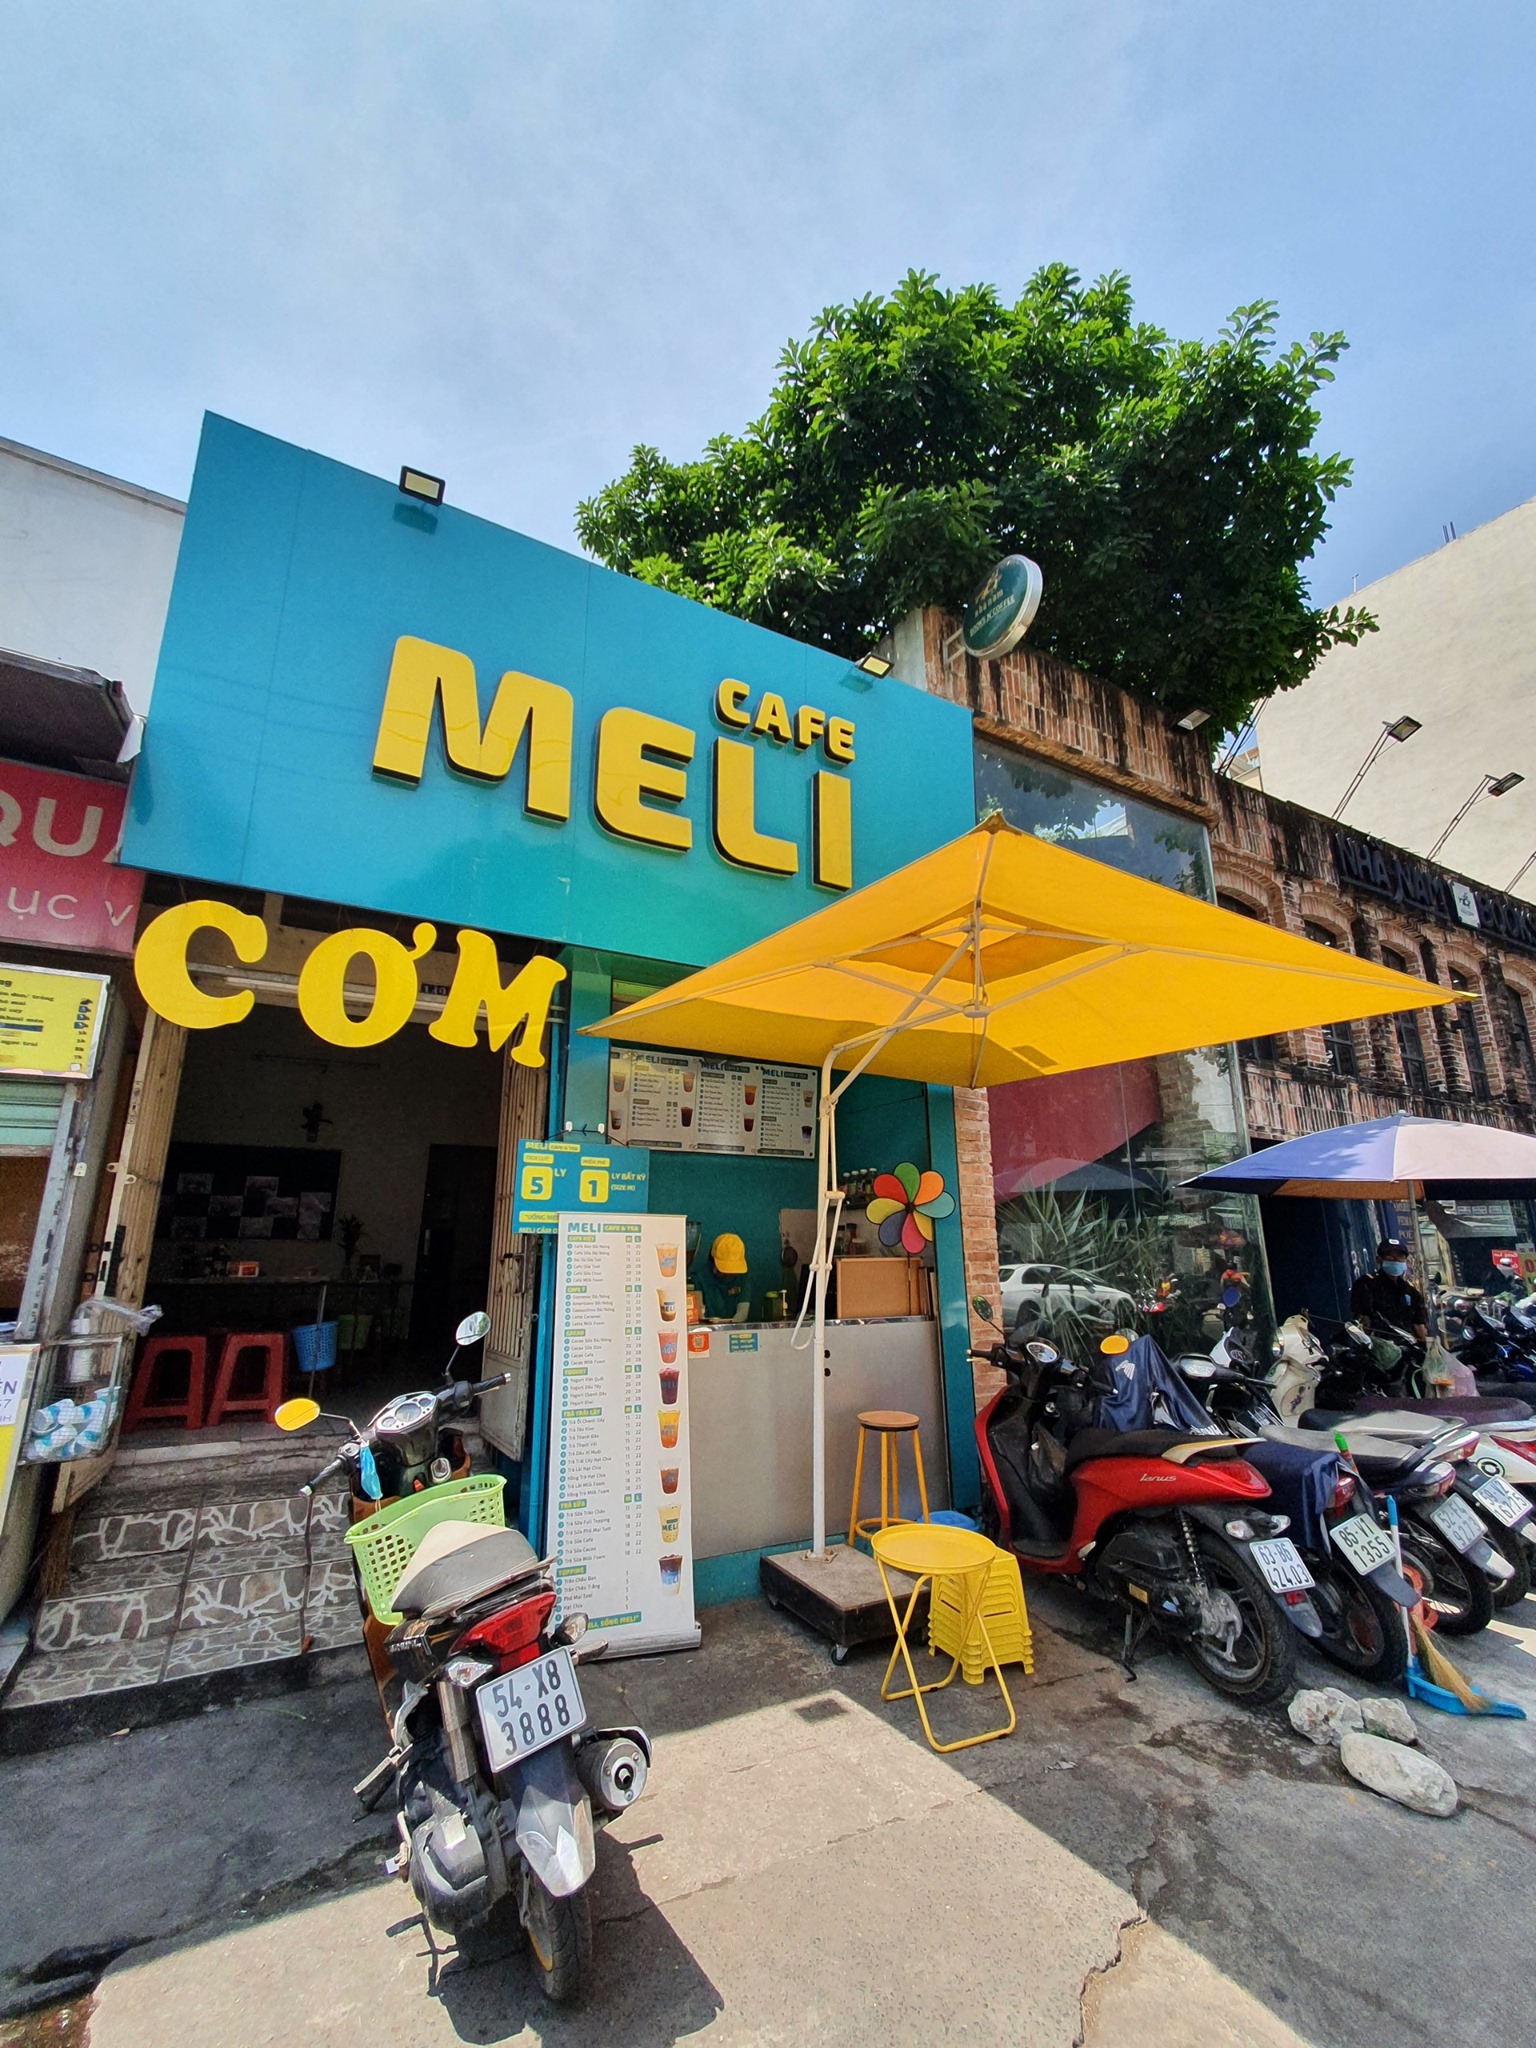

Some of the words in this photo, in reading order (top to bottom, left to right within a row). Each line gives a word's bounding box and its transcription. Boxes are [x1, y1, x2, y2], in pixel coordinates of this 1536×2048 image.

[714, 678, 855, 766] CAFE
[372, 635, 853, 892] MELI
[530, 1177, 544, 1194] 5
[554, 1168, 567, 1177] LY
[588, 1180, 598, 1197] 1
[568, 1222, 601, 1232] MELI
[1338, 1518, 1375, 1548] 85-V1
[1258, 1542, 1293, 1566] 63-B6
[1353, 1535, 1391, 1568] 1355
[1266, 1564, 1310, 1588] 424.03
[492, 1659, 562, 1718] 54-X8
[500, 1694, 570, 1756] 3888
